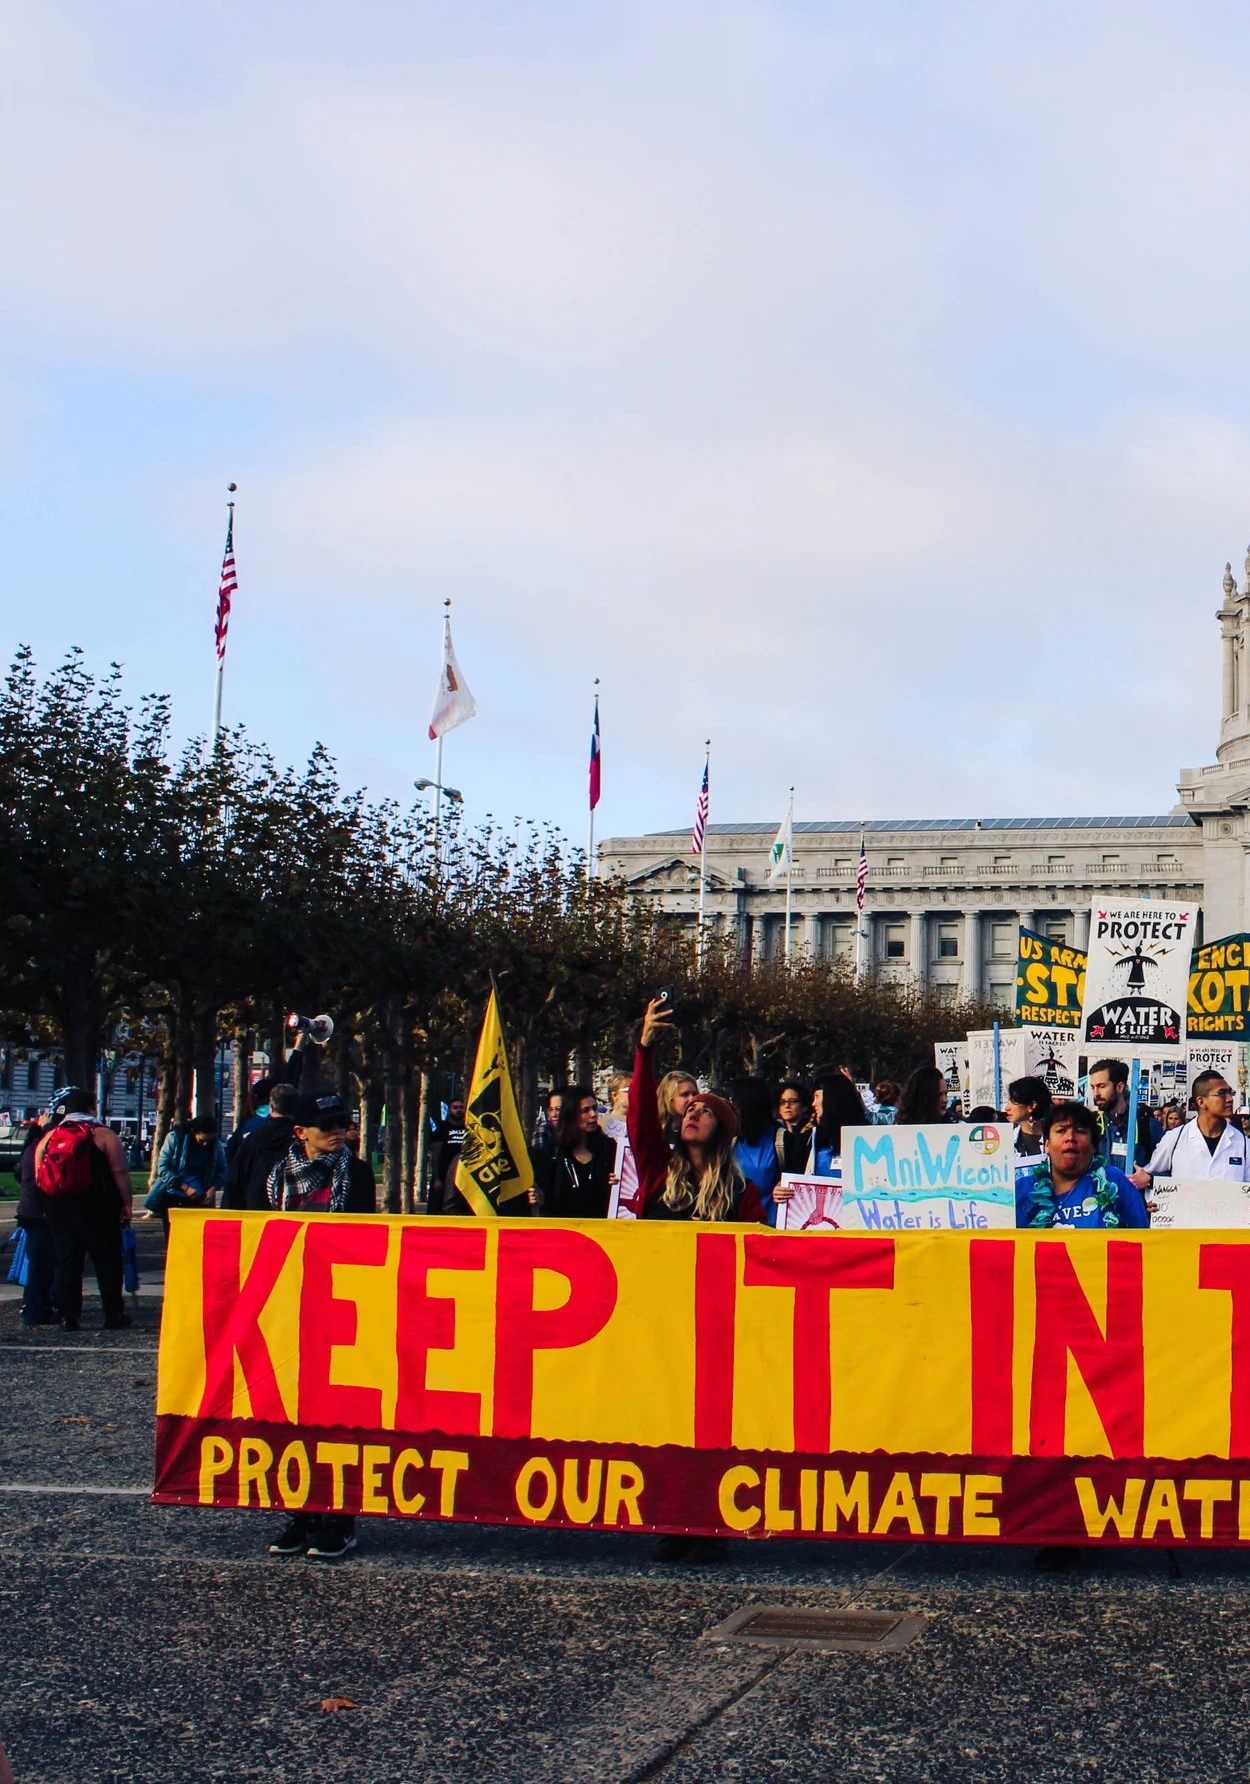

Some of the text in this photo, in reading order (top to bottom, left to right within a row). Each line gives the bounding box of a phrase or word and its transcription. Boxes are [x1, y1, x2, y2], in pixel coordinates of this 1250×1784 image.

[1124, 911, 1140, 919] ARE
[1142, 912, 1162, 920] HERE
[1165, 912, 1176, 920] TO
[1097, 922, 1187, 940] PROTECT
[1020, 936, 1043, 960] US
[1051, 946, 1088, 969] ARM
[1022, 1005, 1082, 1026] RESPECT
[1188, 1015, 1244, 1032] RIGHTS
[1101, 1006, 1174, 1026] WATER
[1031, 1031, 1076, 1042] WATER
[1115, 1025, 1155, 1035] IS LIFE
[1190, 1054, 1232, 1062] PROTECT
[856, 1200, 988, 1230] Water is Life
[197, 1220, 618, 1438] KEEP
[694, 1233, 895, 1454] IT
[969, 1239, 1144, 1460] IN
[198, 1435, 469, 1518] PROTECT
[515, 1456, 645, 1526] OUR
[718, 1464, 1002, 1536] CLIMATE
